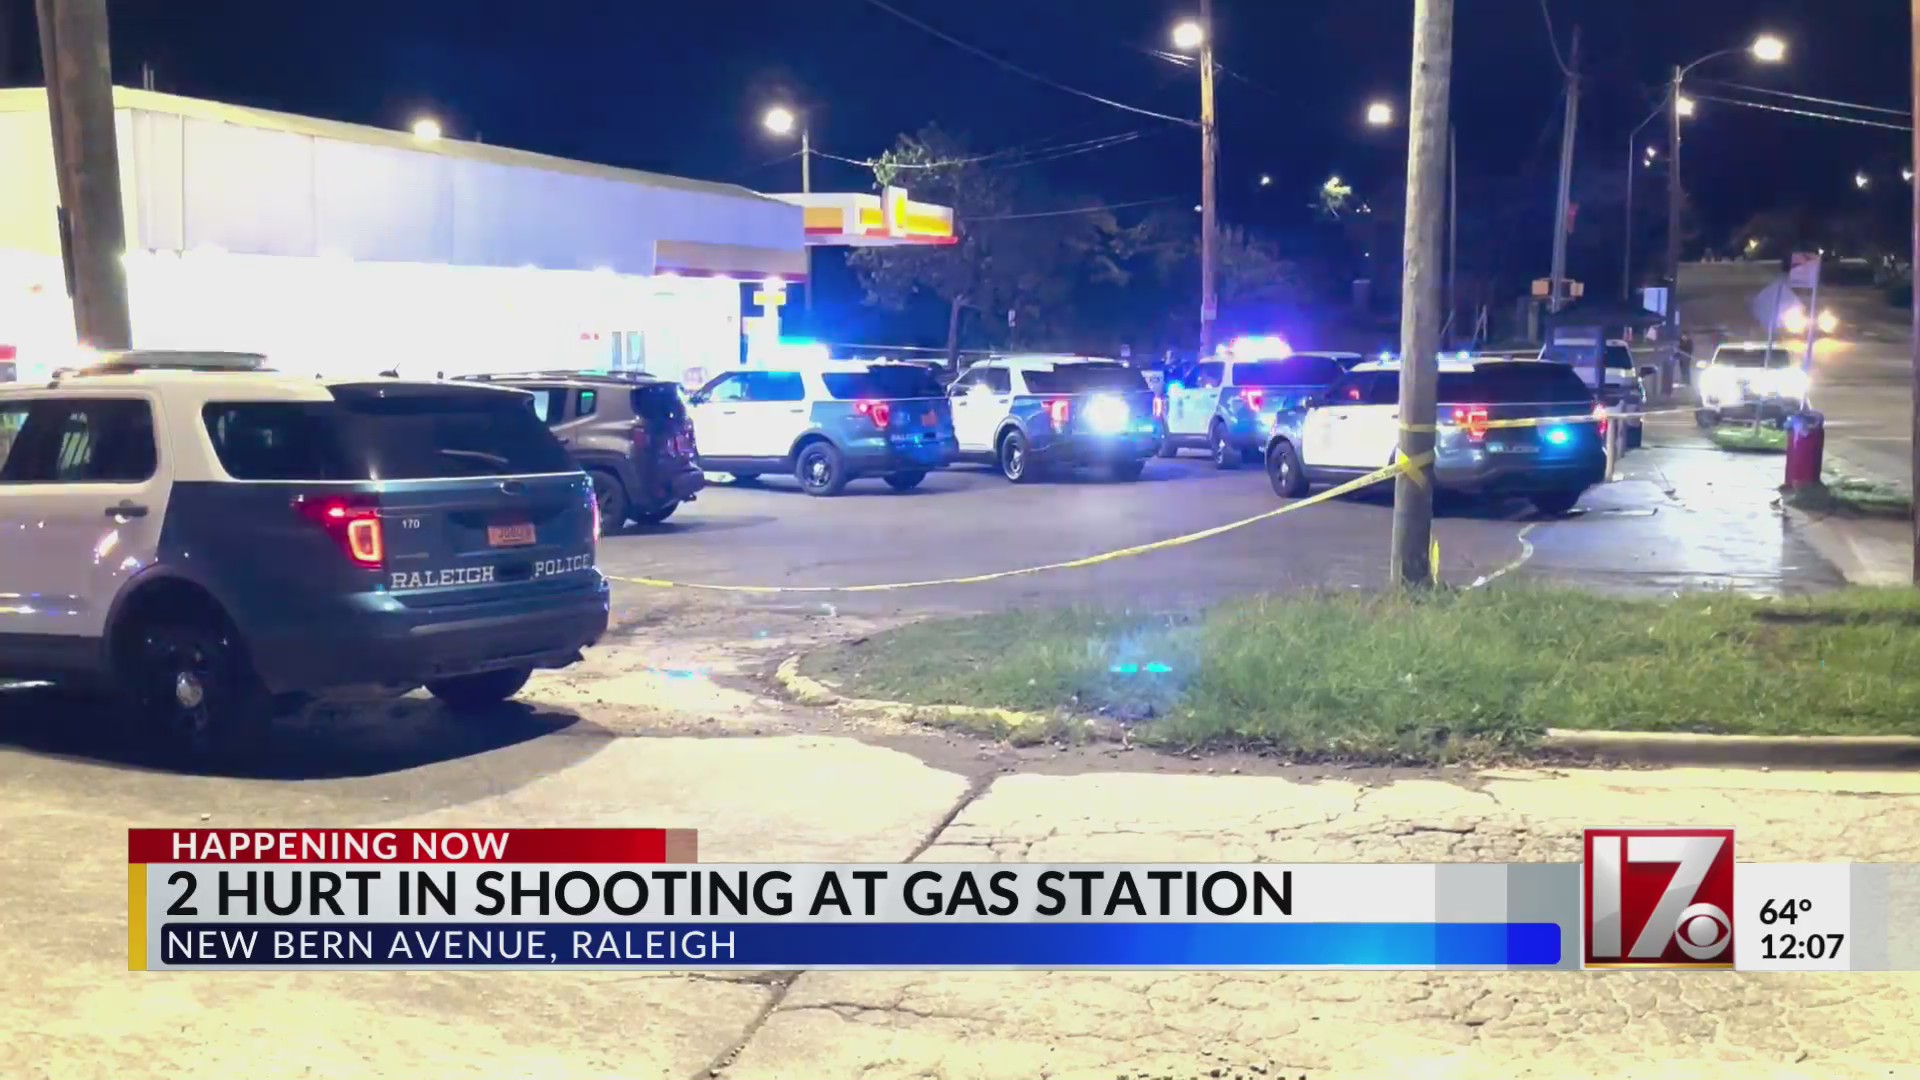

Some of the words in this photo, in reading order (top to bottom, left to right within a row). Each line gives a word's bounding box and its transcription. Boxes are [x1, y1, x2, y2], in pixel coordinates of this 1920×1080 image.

[402, 519, 420, 529] 170
[391, 566, 495, 589] RALEIGH
[534, 554, 591, 577] POLICE
